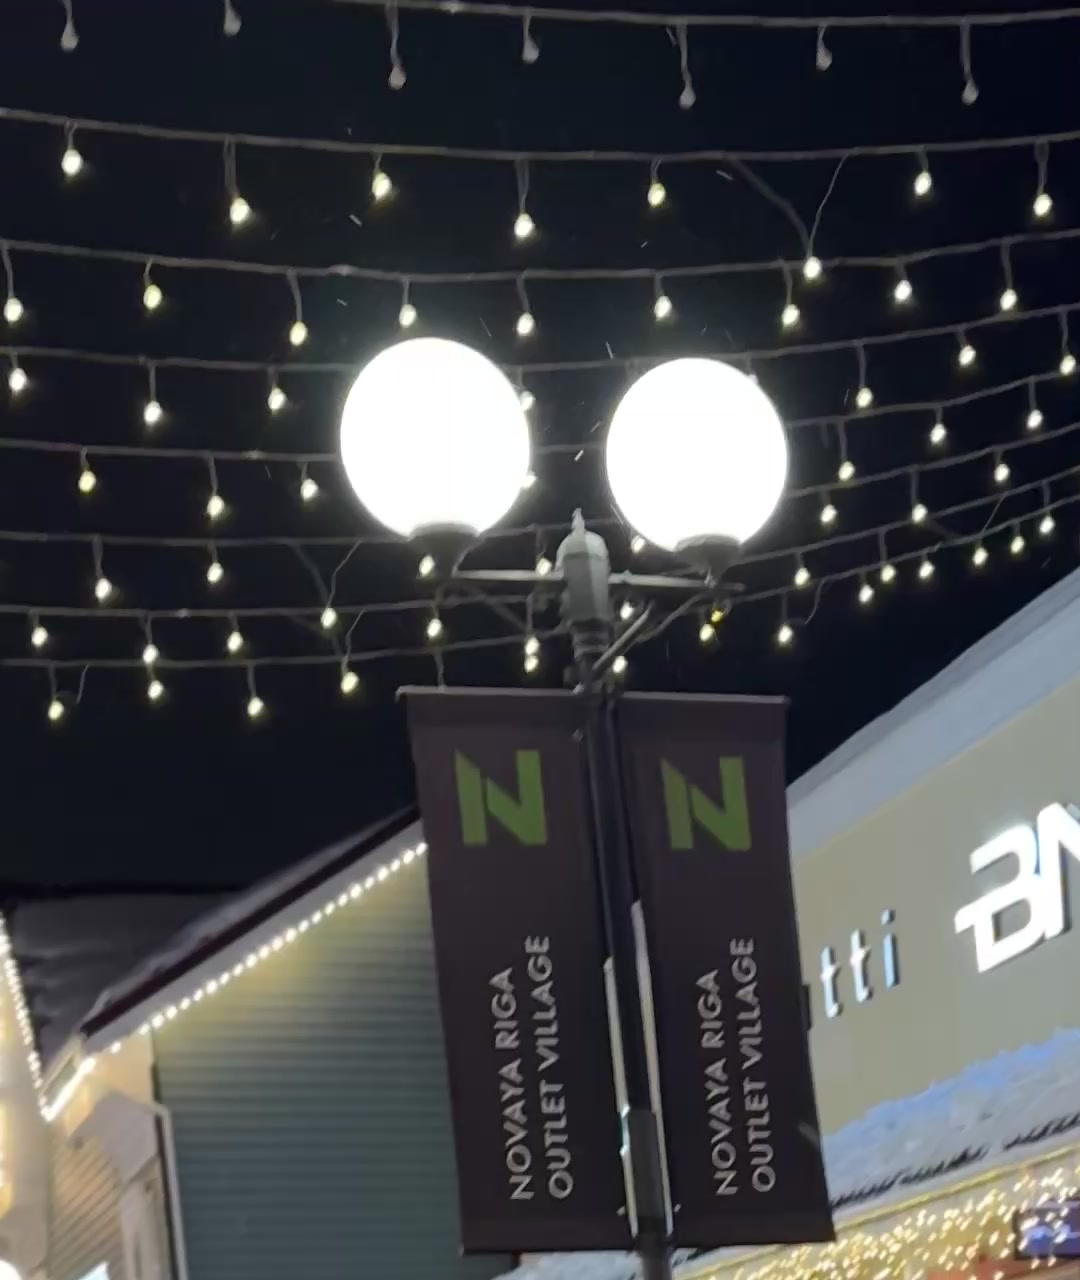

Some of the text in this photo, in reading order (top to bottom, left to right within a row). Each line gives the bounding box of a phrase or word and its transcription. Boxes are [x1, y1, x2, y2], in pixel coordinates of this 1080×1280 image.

[488, 967, 535, 1200] NOVAYA RIGA
[524, 935, 574, 1199] OUTLET VILLAGE
[696, 969, 739, 1196] NOVAYA RIGA
[729, 938, 776, 1192] OUTLET VILLAGE
